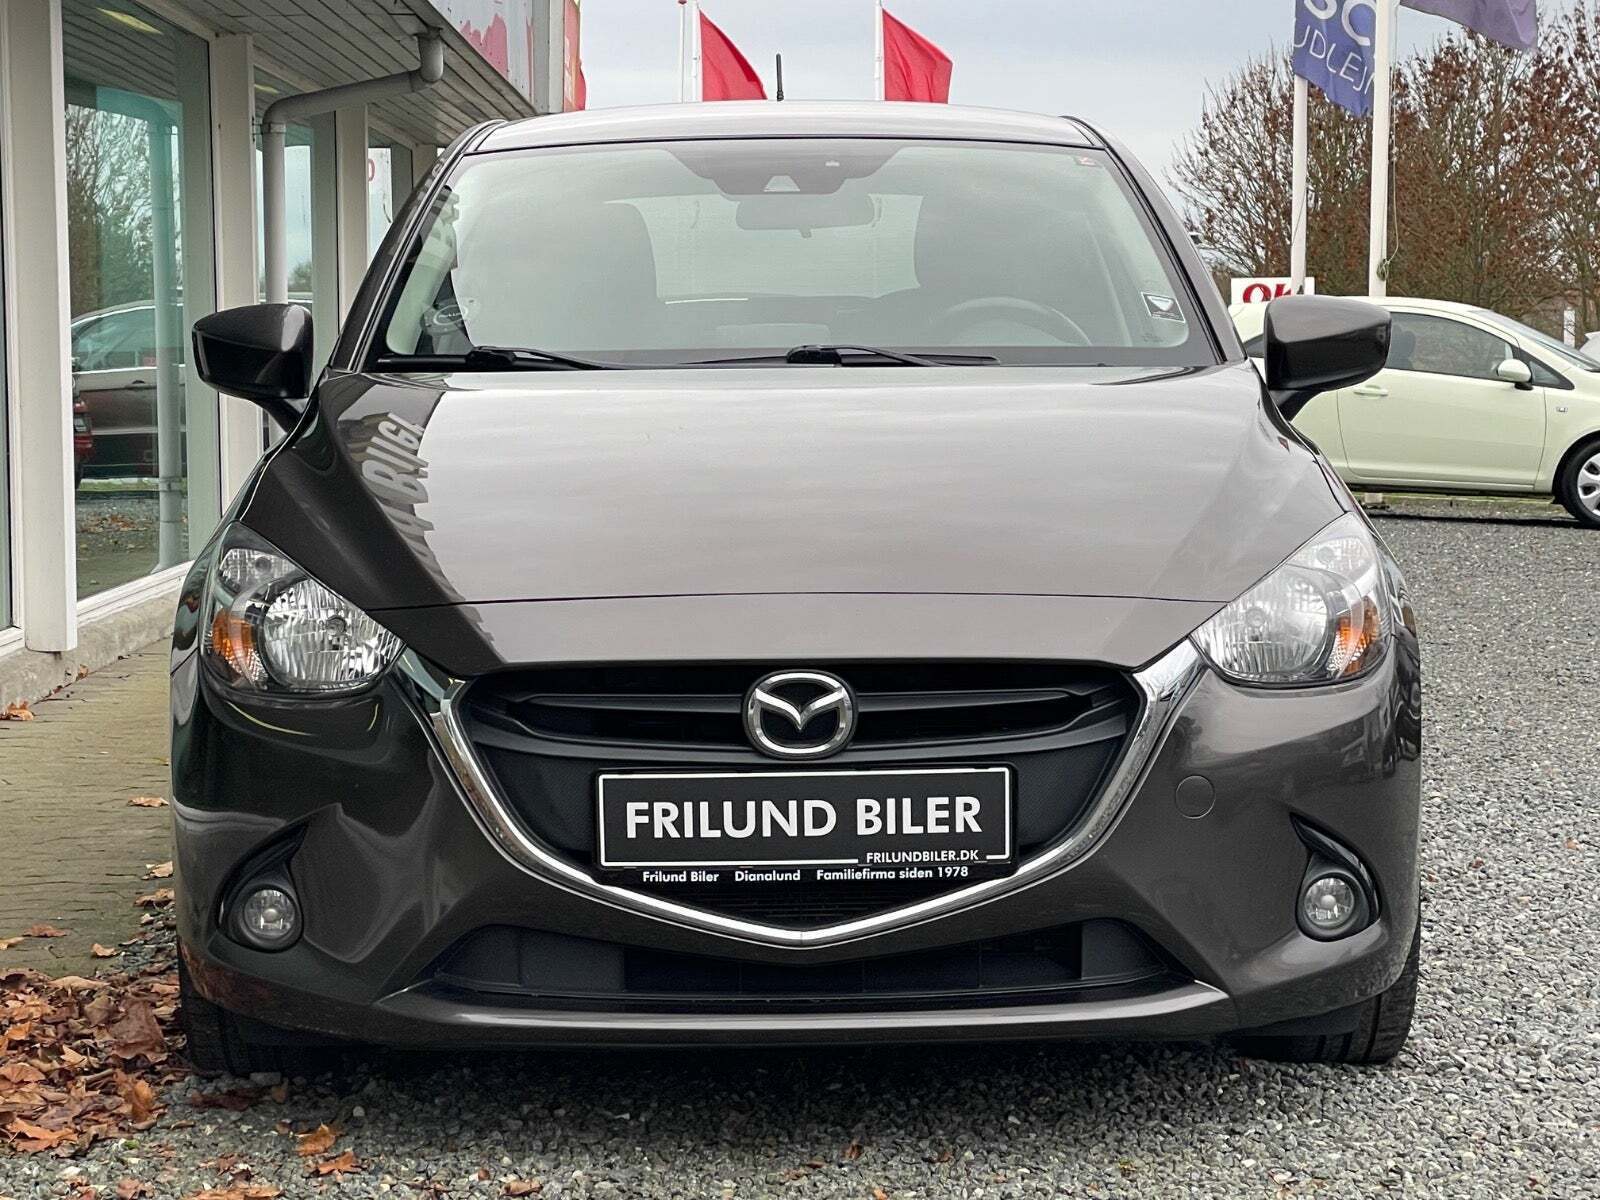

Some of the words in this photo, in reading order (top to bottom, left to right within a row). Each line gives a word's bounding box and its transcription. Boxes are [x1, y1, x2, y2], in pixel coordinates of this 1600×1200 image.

[626, 800, 838, 839] FRILUND
[856, 795, 983, 836] BILER
[866, 849, 980, 864] FRILUNDBILER.DK
[642, 870, 688, 883] Frilund
[690, 870, 720, 883] Biler
[734, 869, 801, 882] Dianalund
[816, 867, 896, 881] Familiefirma
[899, 867, 933, 879] siden
[937, 866, 969, 878] 1978
